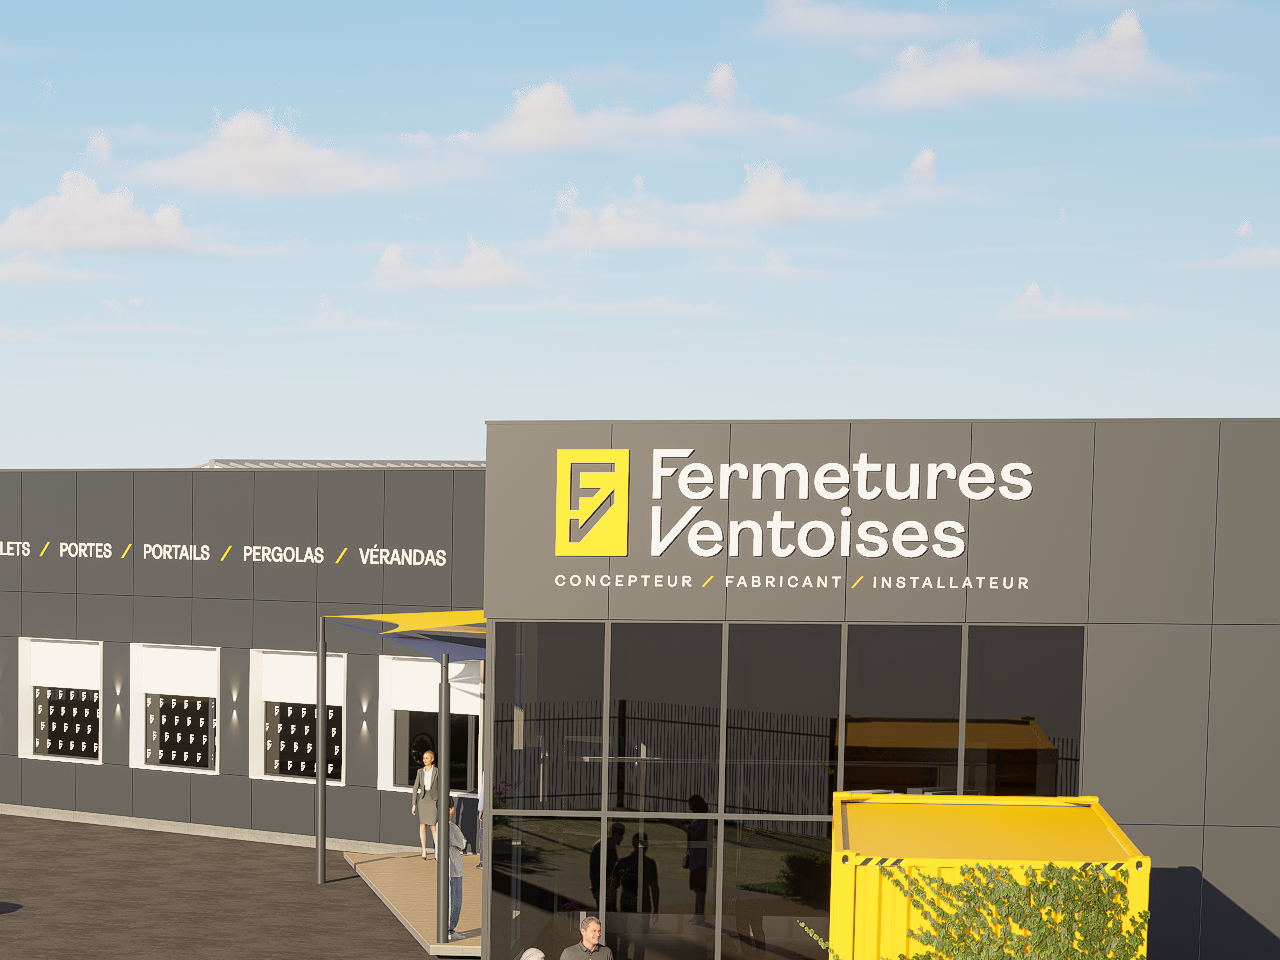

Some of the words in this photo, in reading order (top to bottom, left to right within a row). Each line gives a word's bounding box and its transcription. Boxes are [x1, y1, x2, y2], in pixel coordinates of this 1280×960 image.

[651, 448, 1033, 501] Fermetures
[650, 505, 966, 558] Ventoises
[59, 543, 113, 559] PORTES
[143, 543, 211, 561] PORTAILS
[243, 545, 325, 564] PERGOLAS
[358, 544, 447, 567] VÉRANDAS
[554, 574, 693, 588] CONCEPTEUR
[725, 575, 842, 589] FABRICANT
[872, 576, 1029, 590] INSTALLATEUR
